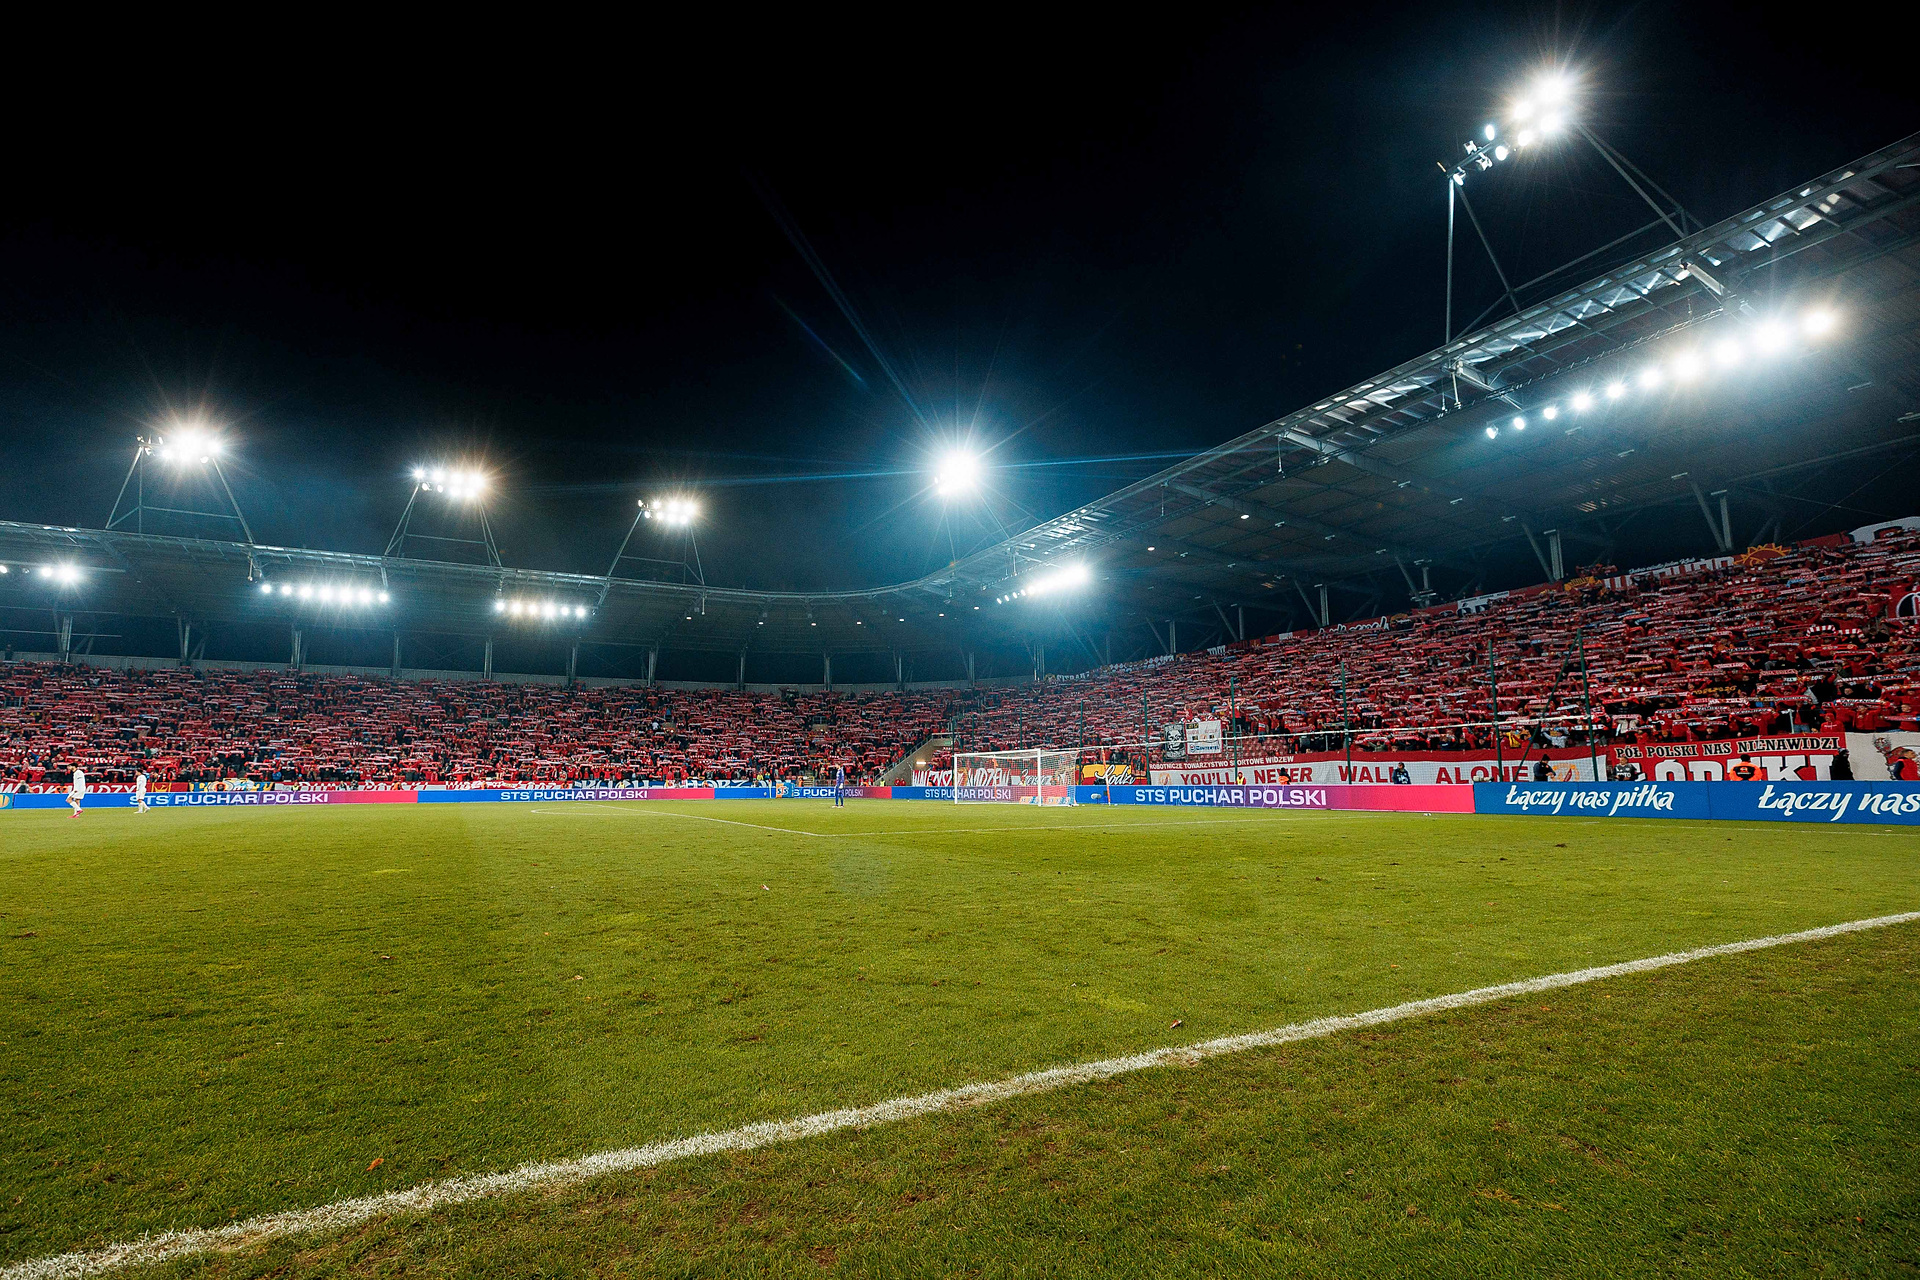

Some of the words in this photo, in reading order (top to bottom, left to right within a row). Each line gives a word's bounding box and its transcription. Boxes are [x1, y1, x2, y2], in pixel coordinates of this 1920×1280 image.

[1616, 745, 1643, 758] PÓŁ
[1647, 744, 1699, 758] POLSKI
[1703, 742, 1732, 755] NAS
[1737, 737, 1840, 753] NIENAWIDZI
[1184, 760, 1229, 769] TOWARZYSTWO
[1229, 758, 1265, 767] SORTOWE
[1266, 755, 1295, 764] WIDZEW
[1436, 766, 1530, 784] ALONE
[175, 794, 257, 805] PUCHAR
[262, 793, 329, 804] POLSKI
[501, 791, 529, 800] STS
[534, 790, 595, 800] PUCHAR
[599, 790, 648, 799] POLSKI
[925, 789, 940, 798] STS
[941, 789, 976, 799] PUCHAR
[978, 789, 1011, 799] POLSKI
[1136, 789, 1166, 802] STS
[1170, 789, 1244, 804] PUCHAR
[1250, 790, 1326, 805] POLSKI
[1506, 785, 1563, 814] Łączy
[1569, 791, 1611, 807] nas
[1608, 785, 1675, 817] piłka
[1758, 785, 1853, 821] Łączy
[1858, 793, 1920, 815] nas
